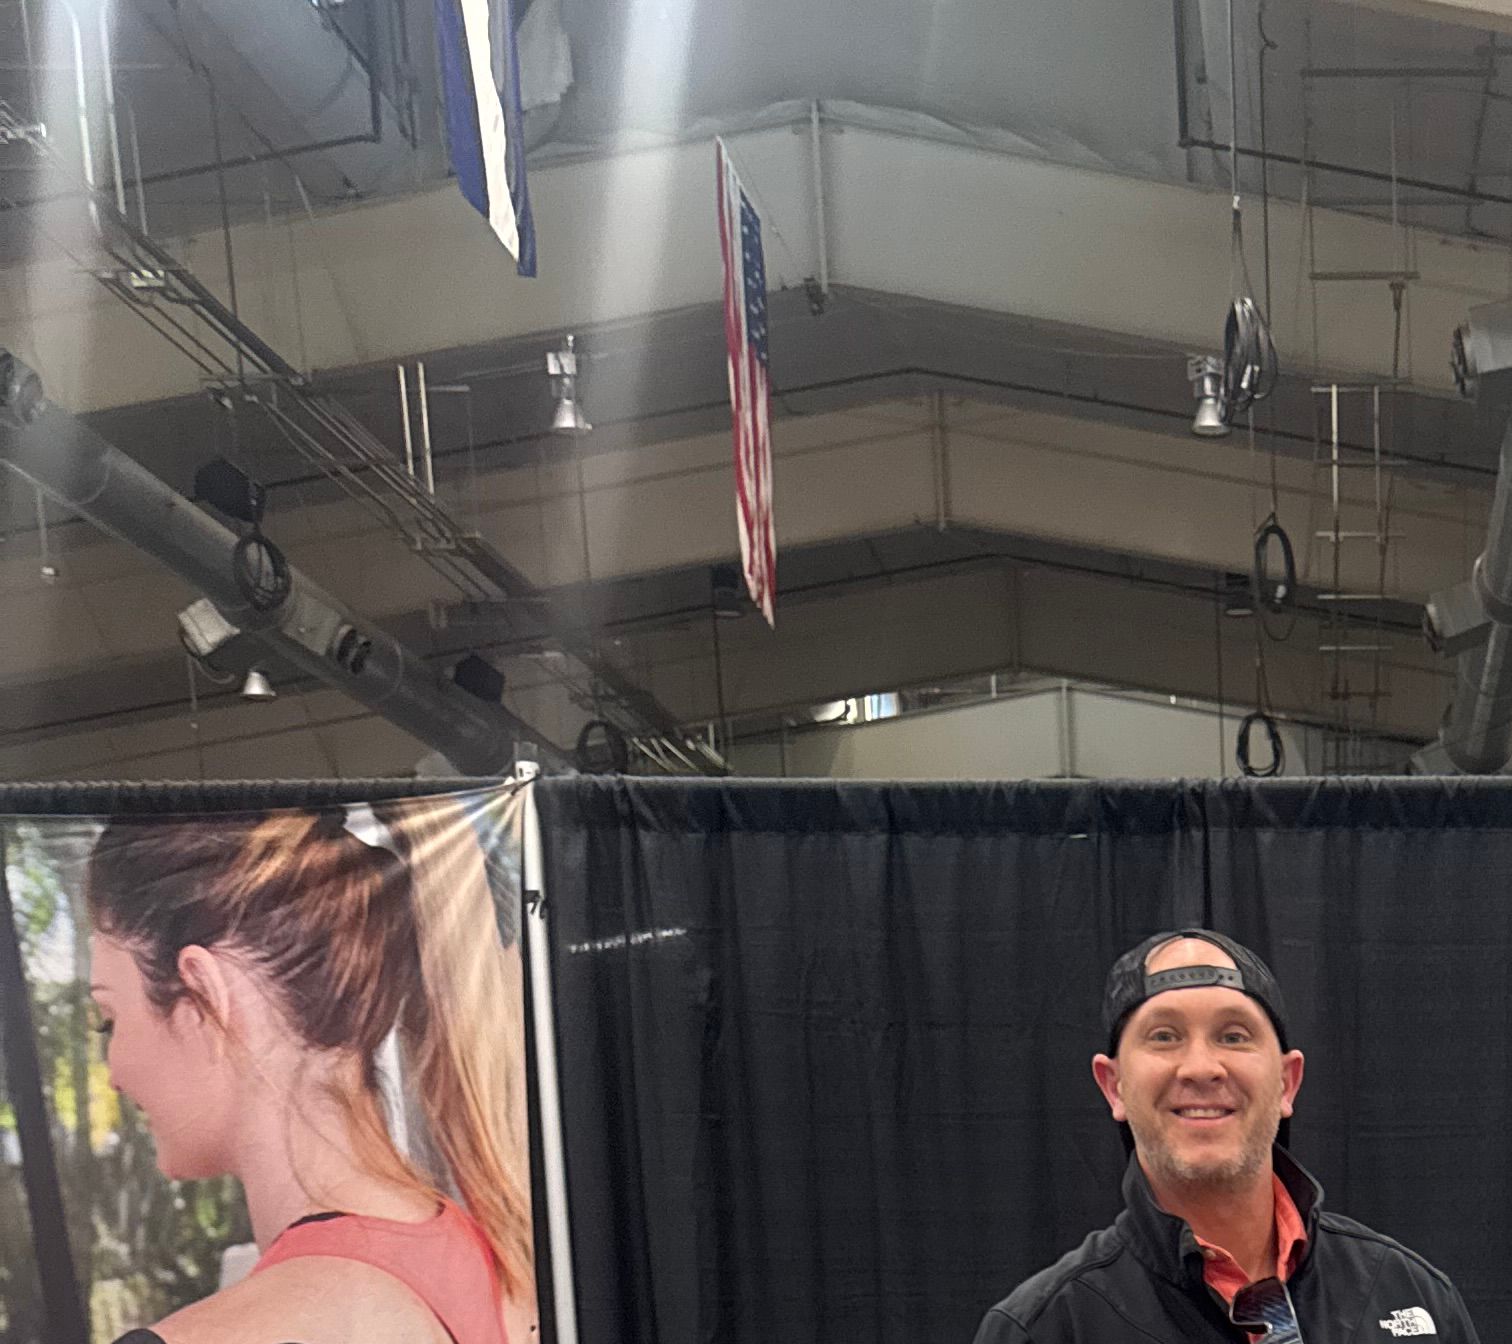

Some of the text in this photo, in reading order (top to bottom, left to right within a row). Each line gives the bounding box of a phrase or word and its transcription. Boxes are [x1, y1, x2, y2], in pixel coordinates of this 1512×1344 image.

[1390, 1309, 1414, 1320] THE
[1379, 1319, 1416, 1330] NORTH
[1391, 1327, 1420, 1337] FACE
